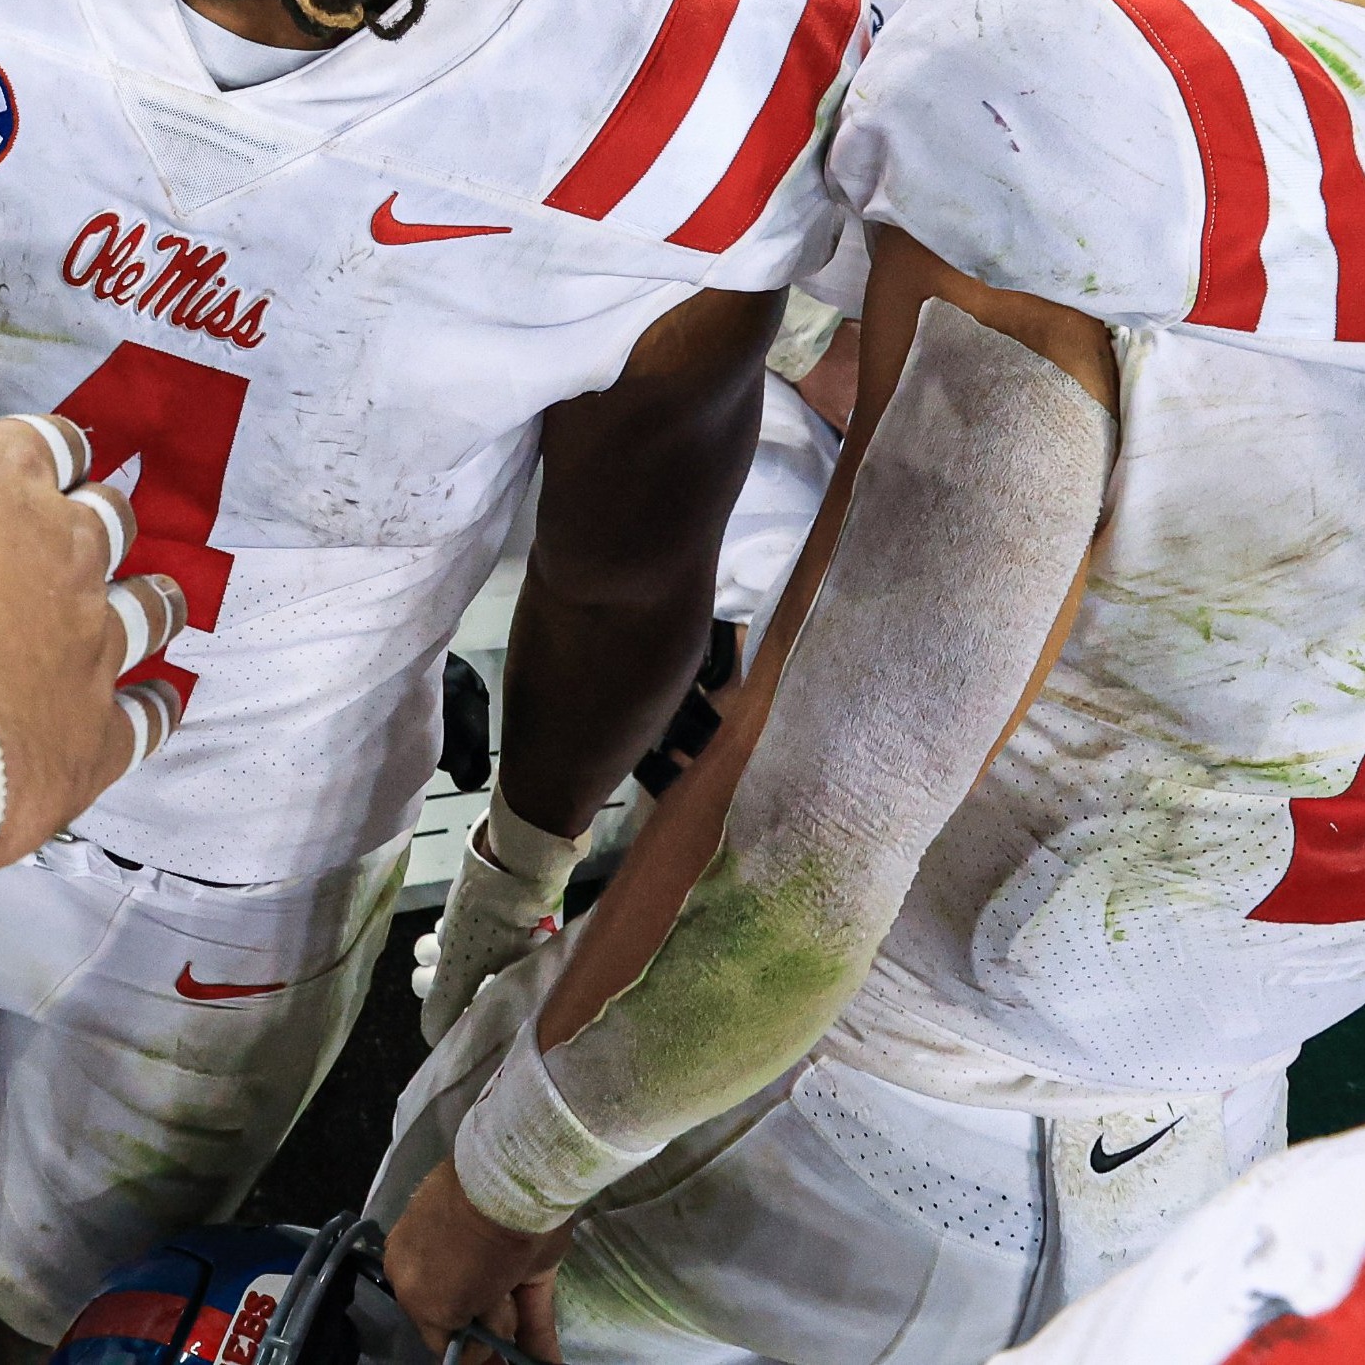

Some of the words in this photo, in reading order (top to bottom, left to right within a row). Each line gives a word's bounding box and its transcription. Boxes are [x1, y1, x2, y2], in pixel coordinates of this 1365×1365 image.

[61, 209, 149, 306] Ole
[137, 234, 272, 350] Miss
[49, 340, 251, 726] 4
[217, 1289, 279, 1365] EBS
